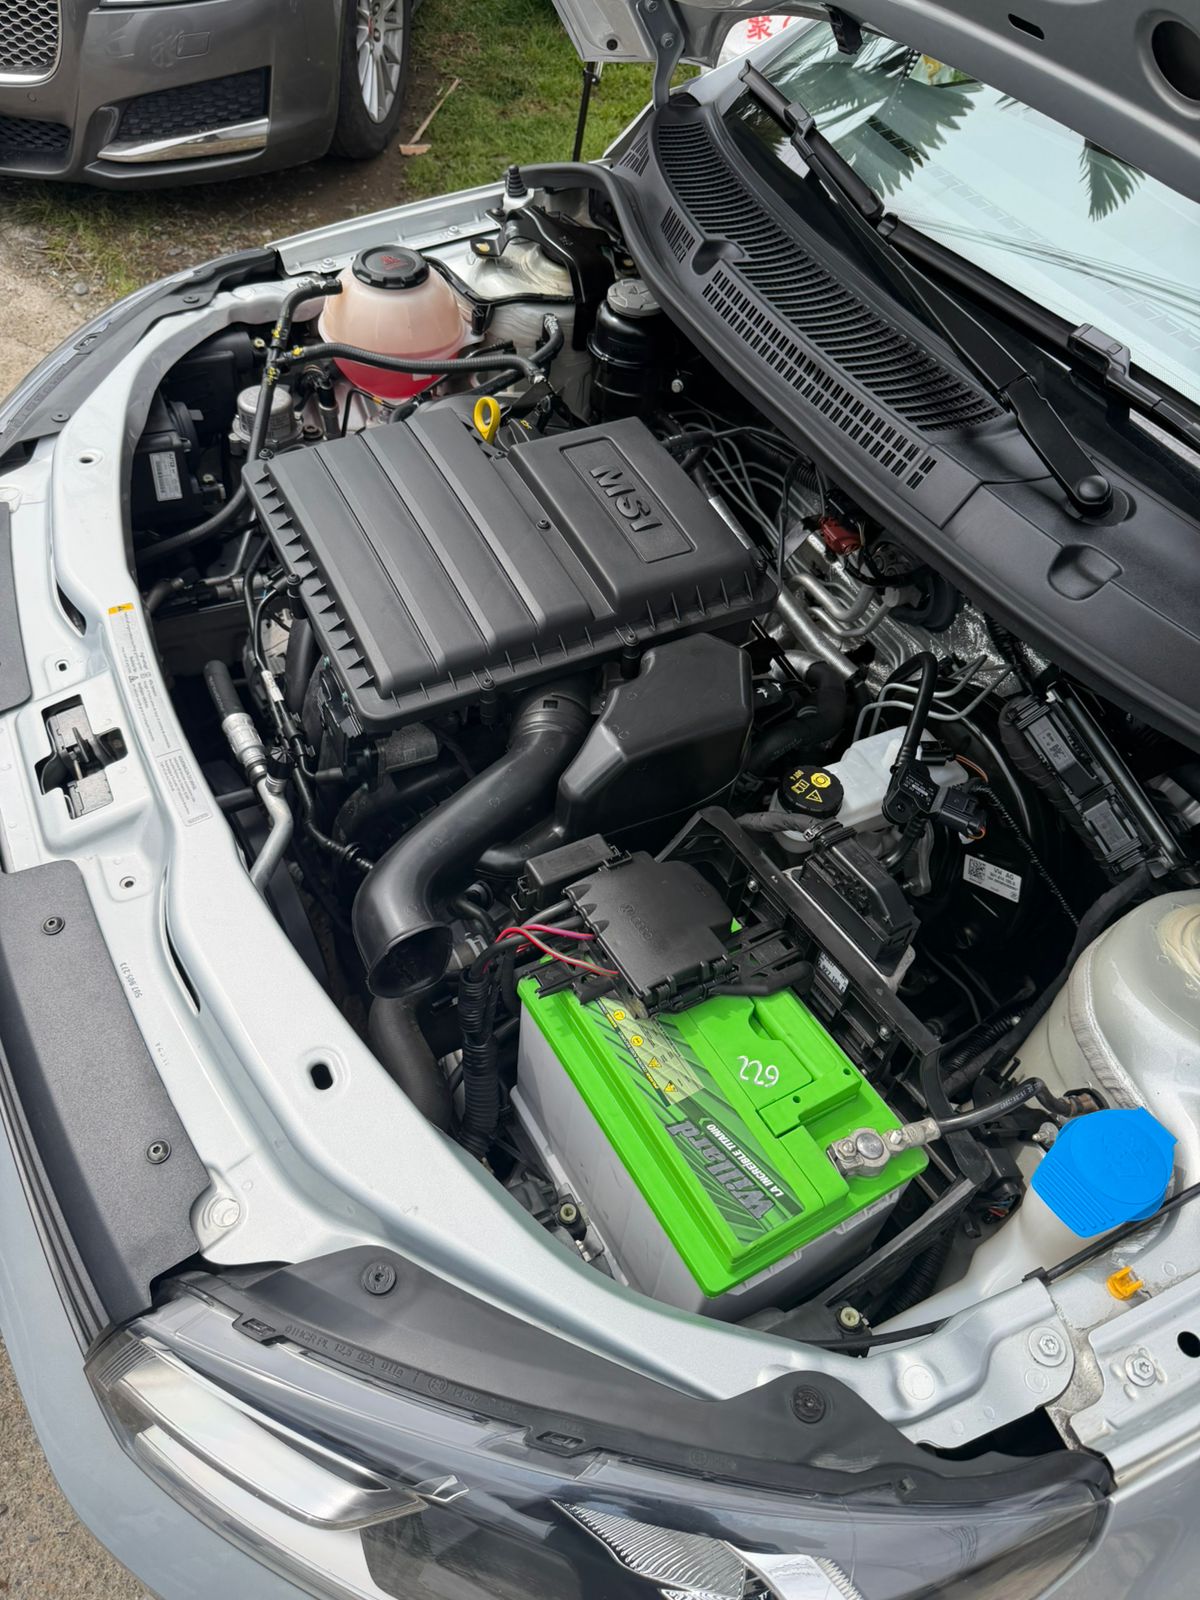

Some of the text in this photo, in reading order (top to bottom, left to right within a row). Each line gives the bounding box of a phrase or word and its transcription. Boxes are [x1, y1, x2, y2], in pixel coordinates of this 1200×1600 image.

[589, 464, 663, 533] MSI
[737, 1055, 779, 1088] 229
[706, 1123, 736, 1151] TITANIO
[665, 1119, 775, 1219] Willard
[769, 1184, 785, 1198] LA
